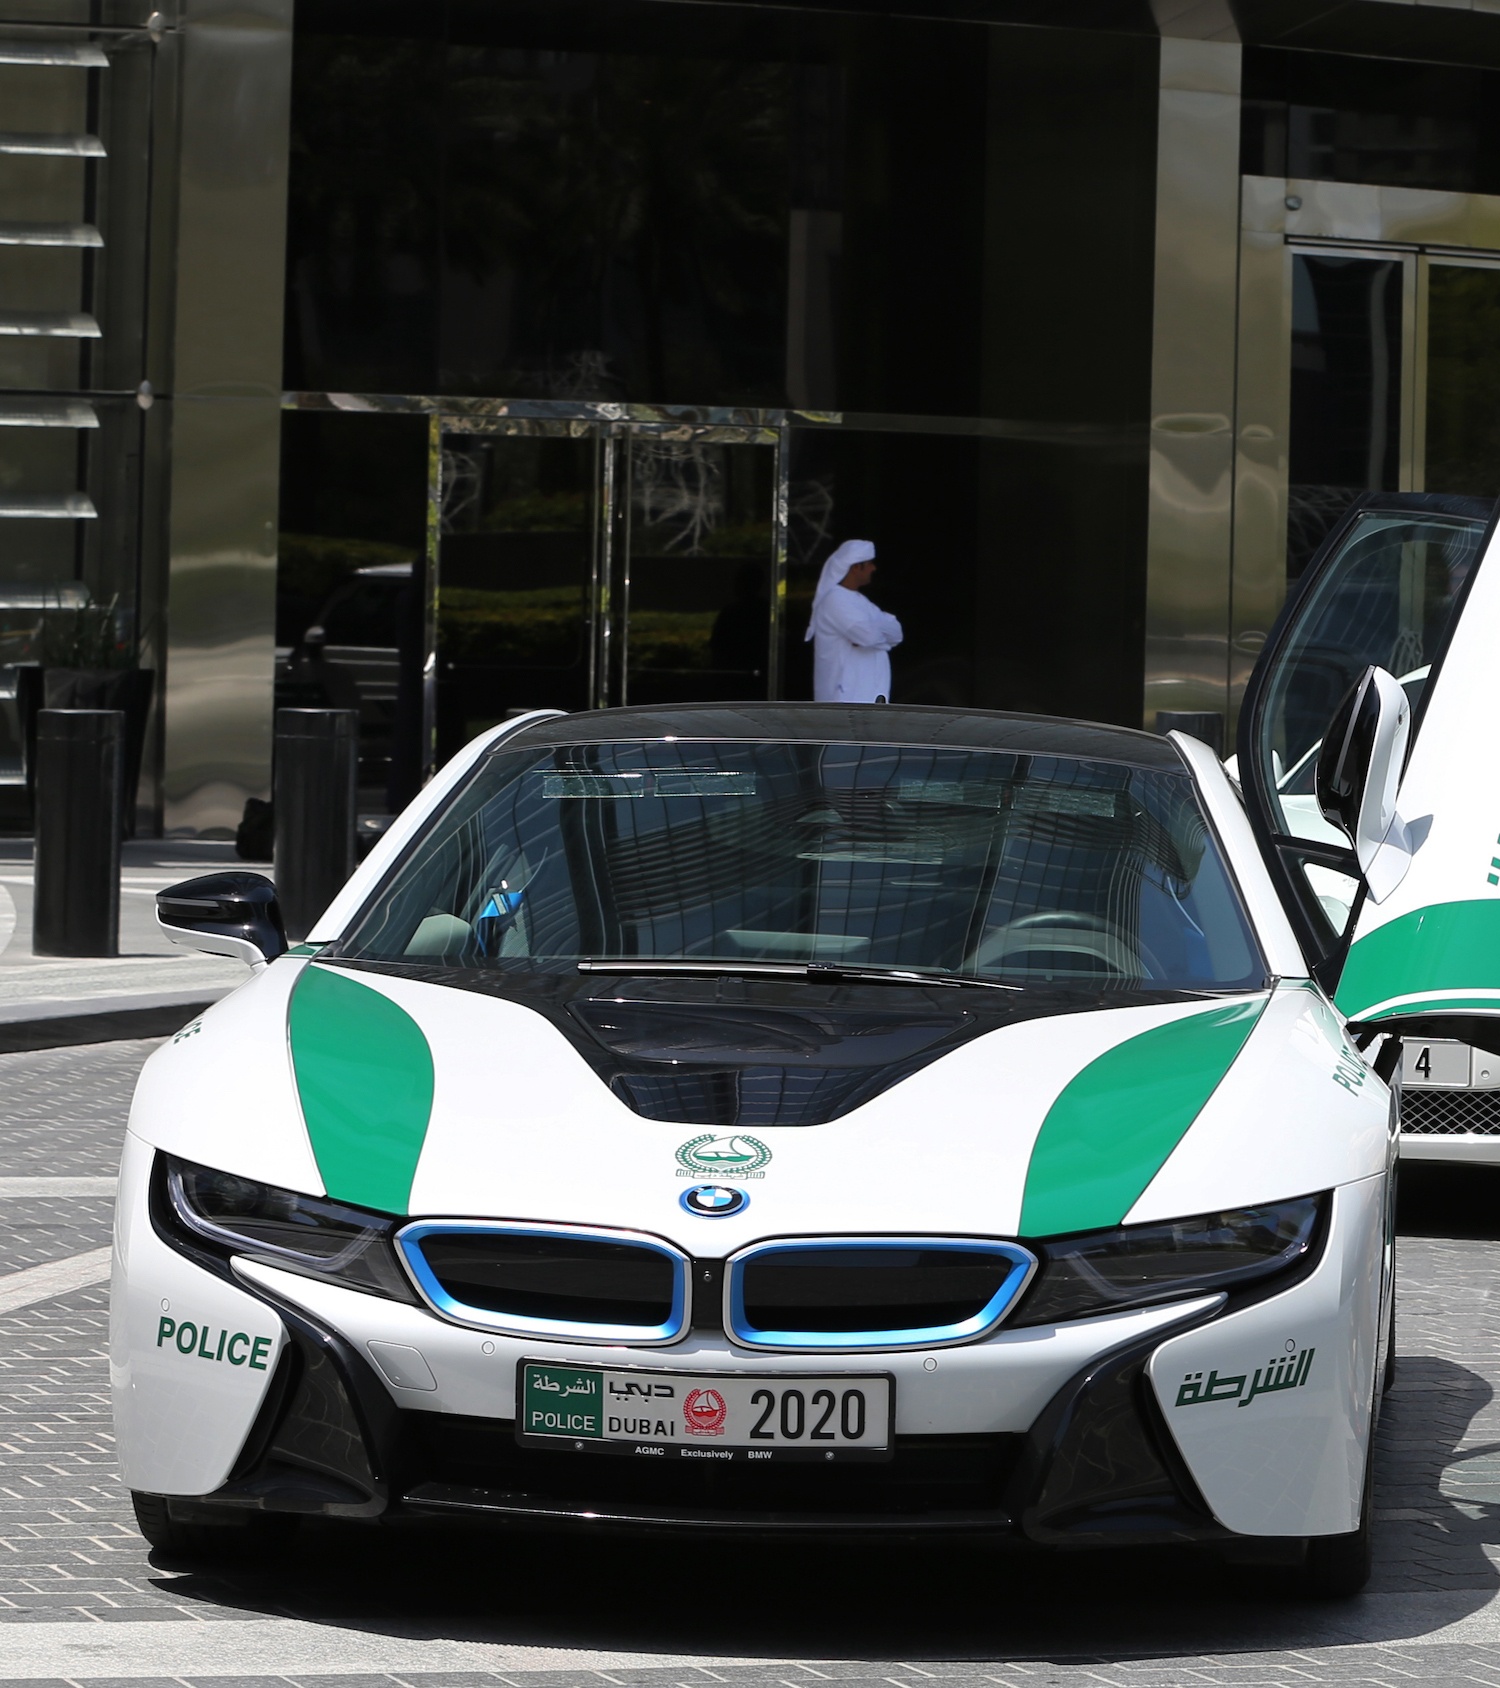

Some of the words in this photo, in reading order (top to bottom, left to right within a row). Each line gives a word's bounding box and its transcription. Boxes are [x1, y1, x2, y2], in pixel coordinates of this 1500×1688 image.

[1415, 1046, 1431, 1079] 4
[157, 1316, 272, 1371] POLICE
[533, 1374, 596, 1397] الشرطة
[1174, 1347, 1316, 1408] الشرطة
[609, 1380, 675, 1404] دبي
[531, 1411, 596, 1432] POLICE
[608, 1416, 675, 1437] DUBAI
[749, 1389, 866, 1440] 2020
[635, 1446, 665, 1456] AGMC
[680, 1448, 734, 1460] Exclusively
[748, 1450, 773, 1459] BMW
